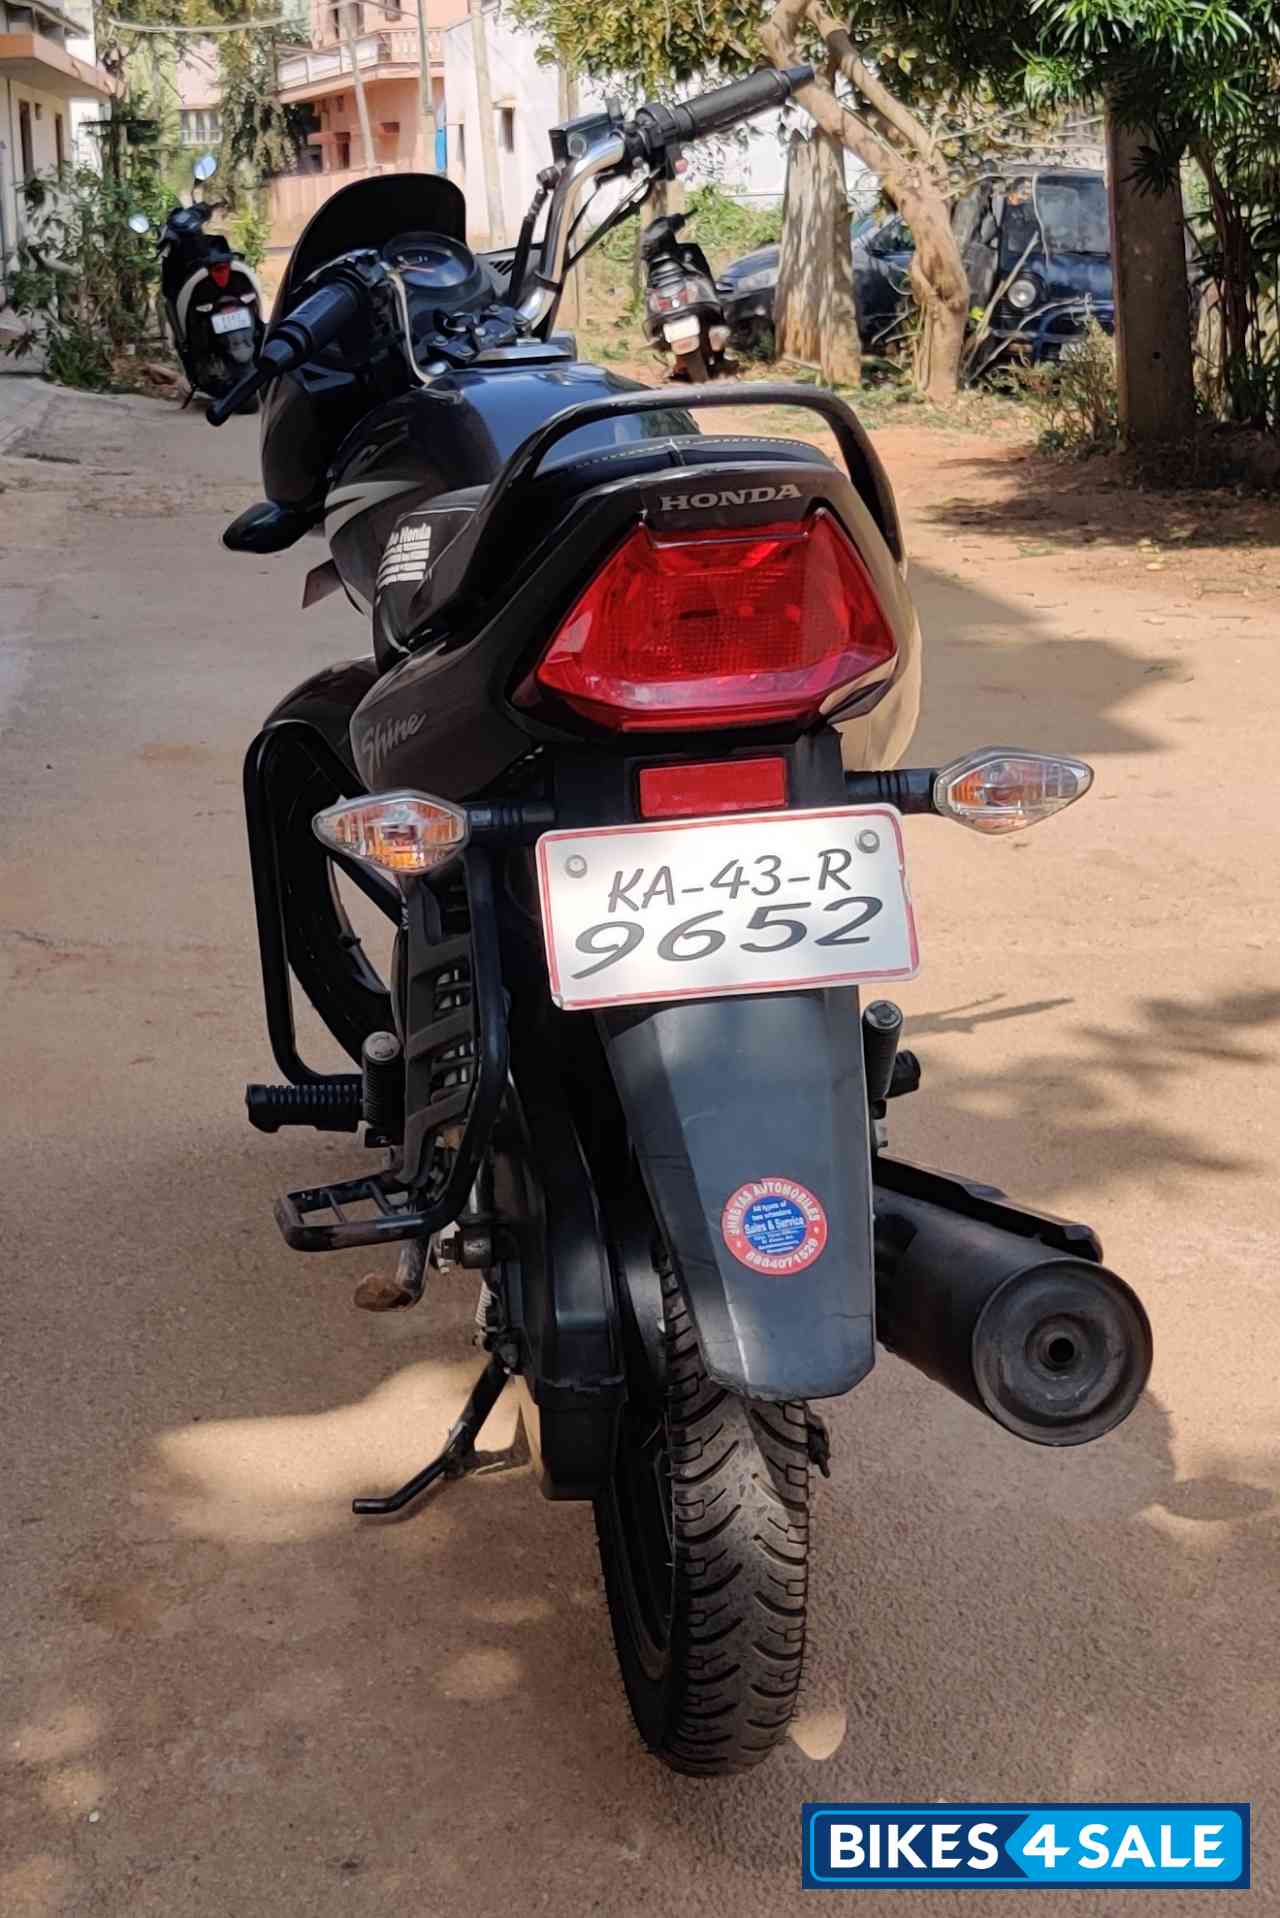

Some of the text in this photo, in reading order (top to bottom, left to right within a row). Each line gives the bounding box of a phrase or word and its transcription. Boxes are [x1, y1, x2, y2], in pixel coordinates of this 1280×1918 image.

[660, 484, 802, 511] HONDA
[608, 848, 852, 913] KA-43-R
[571, 896, 883, 979] 9652
[753, 1182, 819, 1221] AUTOMOBILES
[744, 1223, 767, 1234] Sales
[775, 1217, 804, 1229] Service
